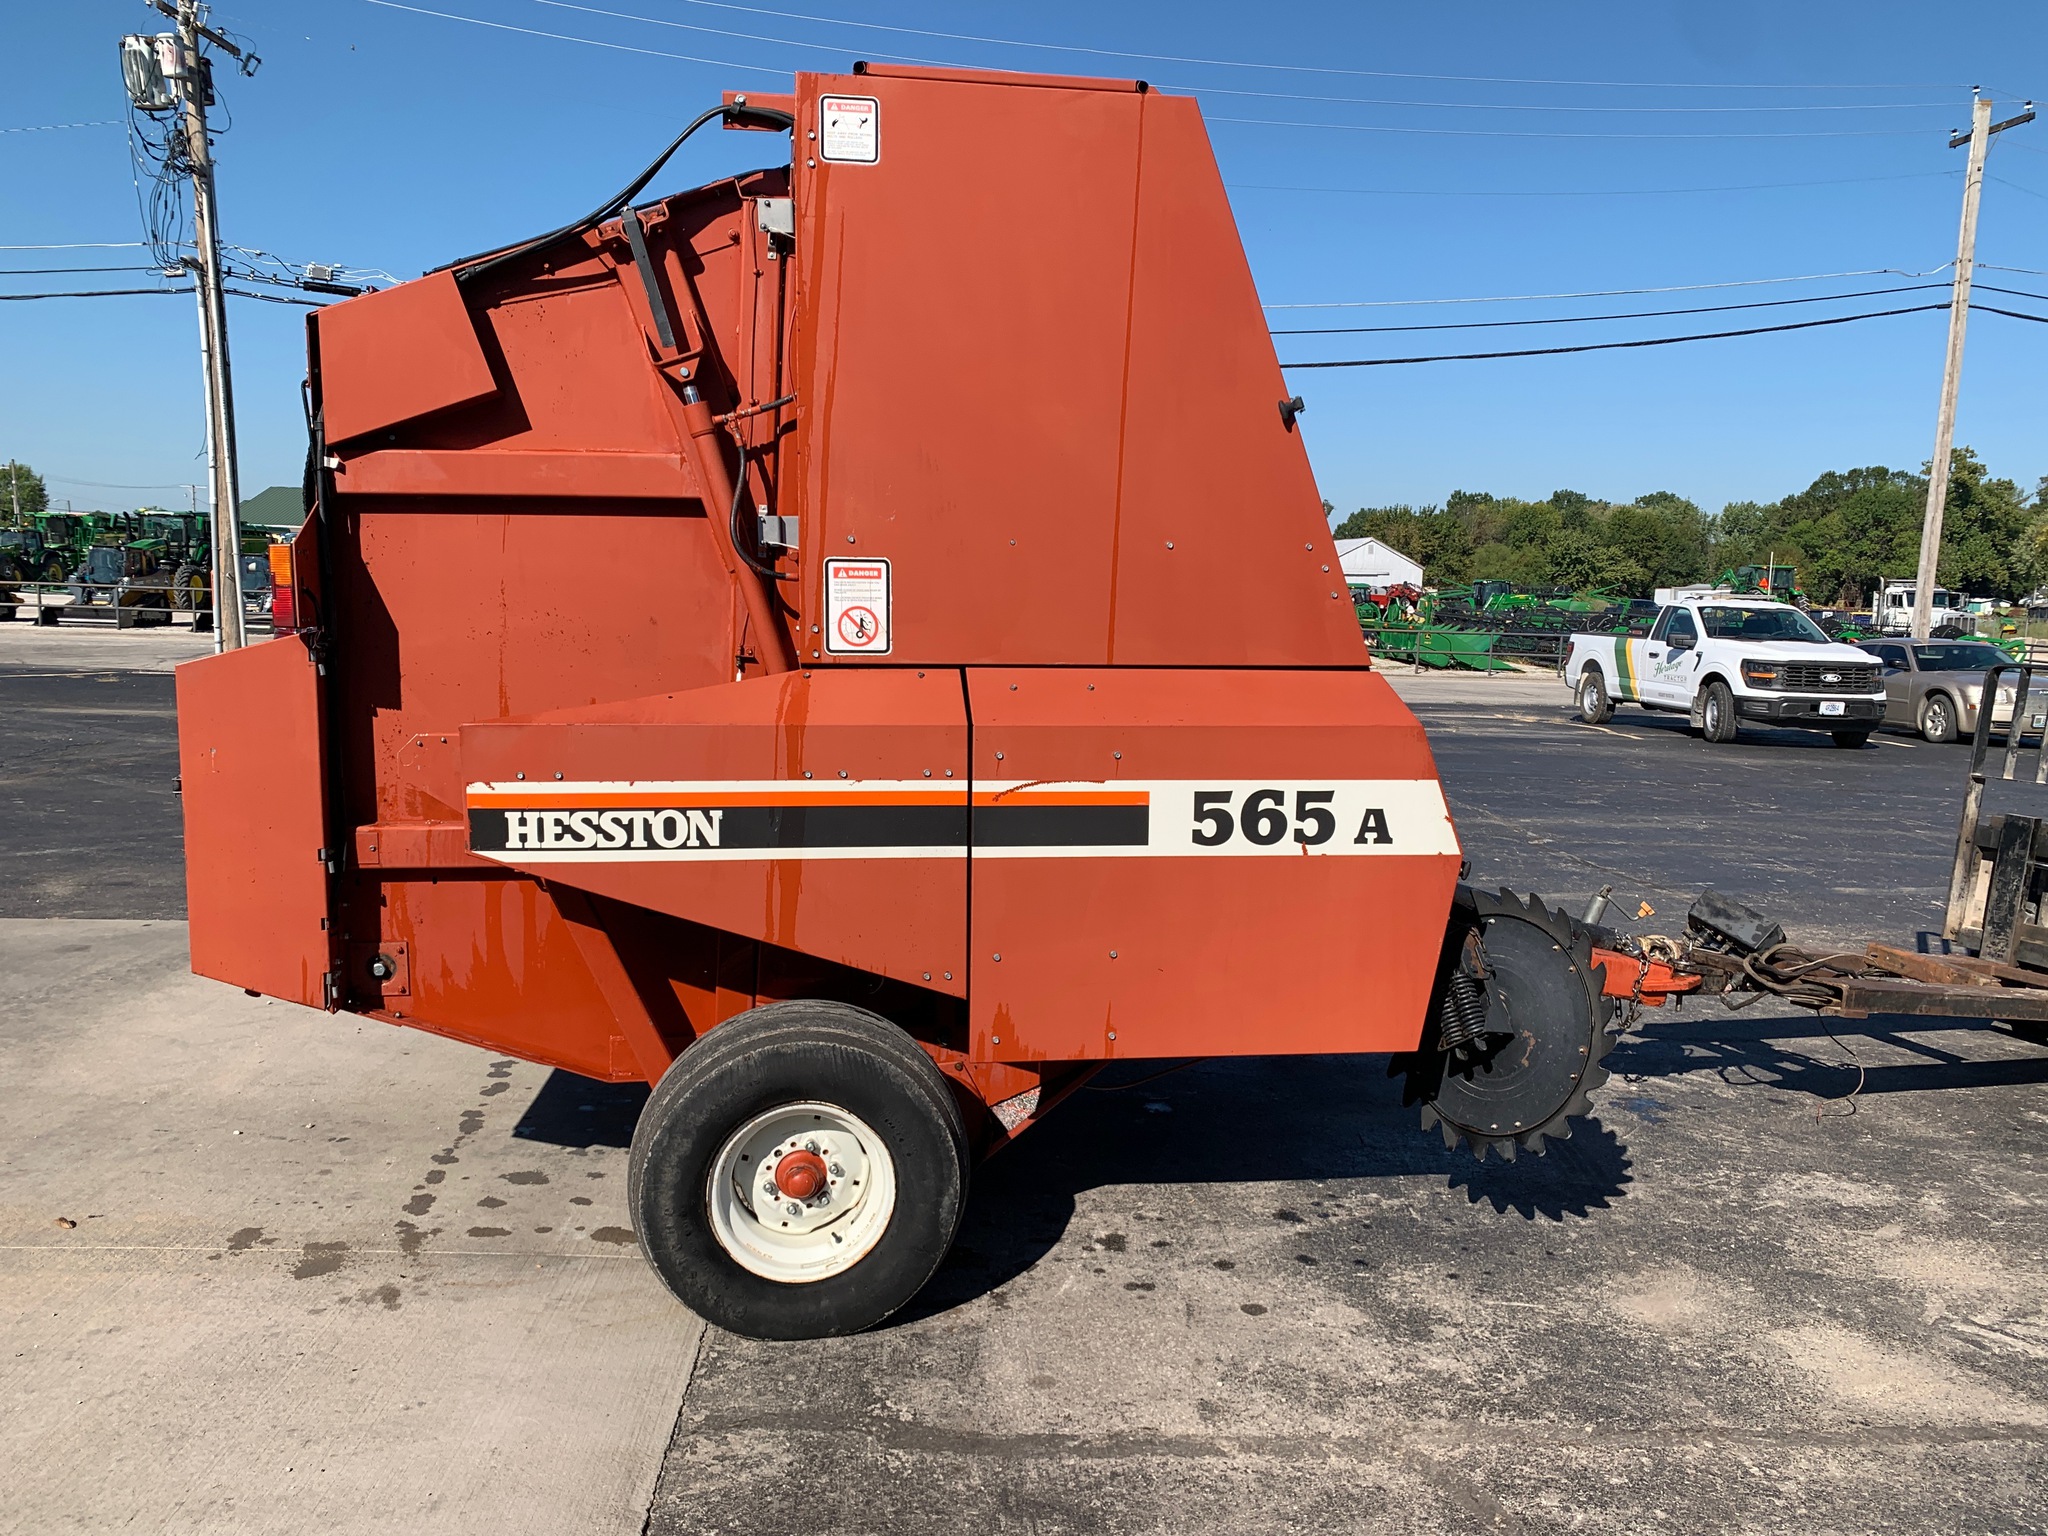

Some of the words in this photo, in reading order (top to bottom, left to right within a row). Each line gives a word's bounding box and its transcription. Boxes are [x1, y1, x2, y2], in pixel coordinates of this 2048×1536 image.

[840, 104, 869, 112] DANGER
[504, 809, 723, 849] HESSTON
[1191, 789, 1336, 847] 565
[1353, 808, 1393, 845] A
